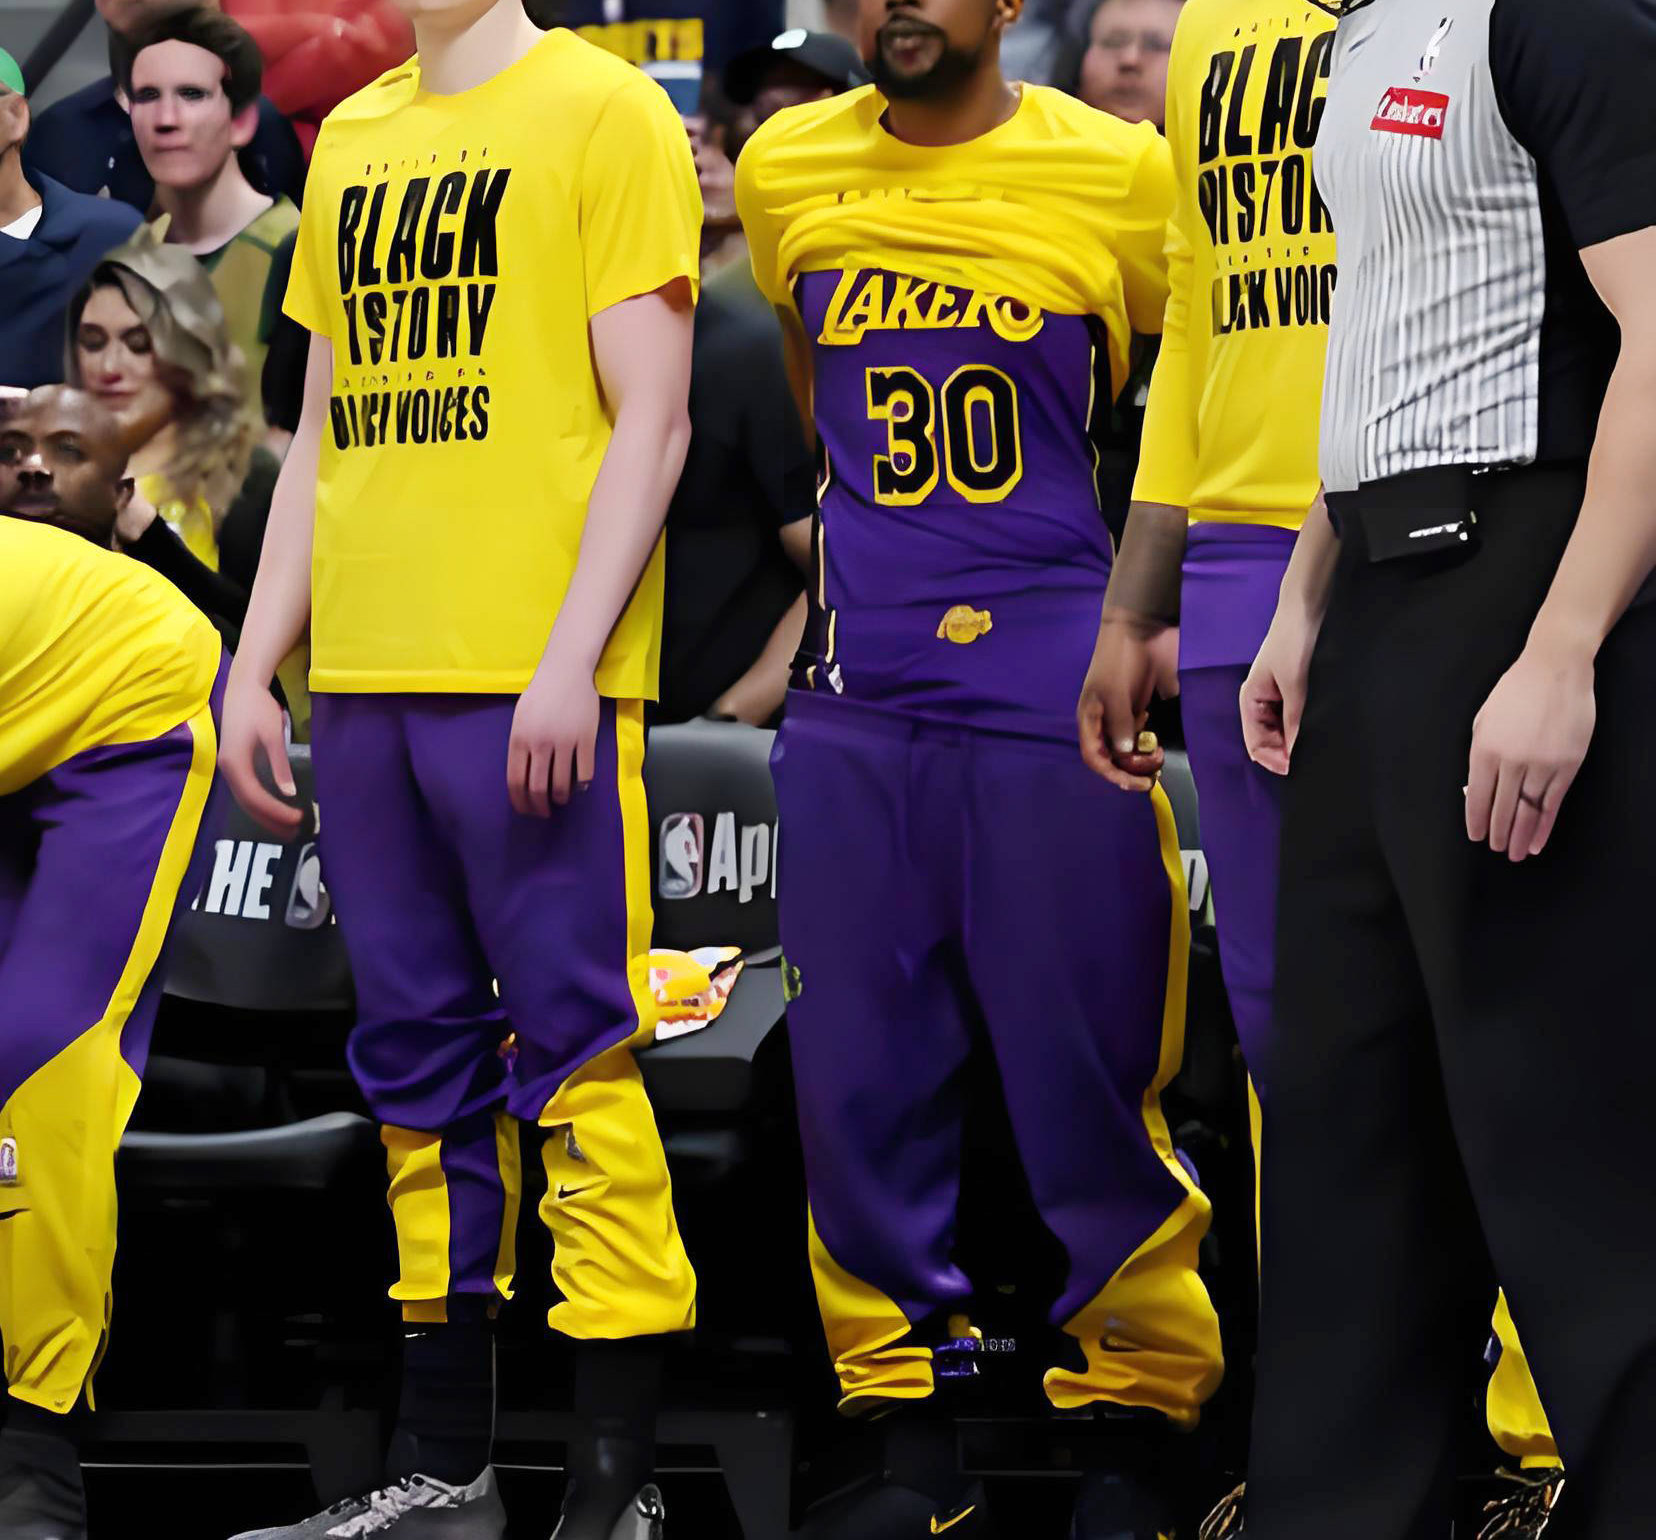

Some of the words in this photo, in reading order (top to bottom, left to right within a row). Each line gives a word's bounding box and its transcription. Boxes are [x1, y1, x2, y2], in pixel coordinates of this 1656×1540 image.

[1199, 29, 1337, 164] BLAC
[338, 168, 512, 295] BLACK
[865, 364, 1023, 506] 30
[191, 839, 283, 919] HE
[707, 812, 779, 904] Ap
